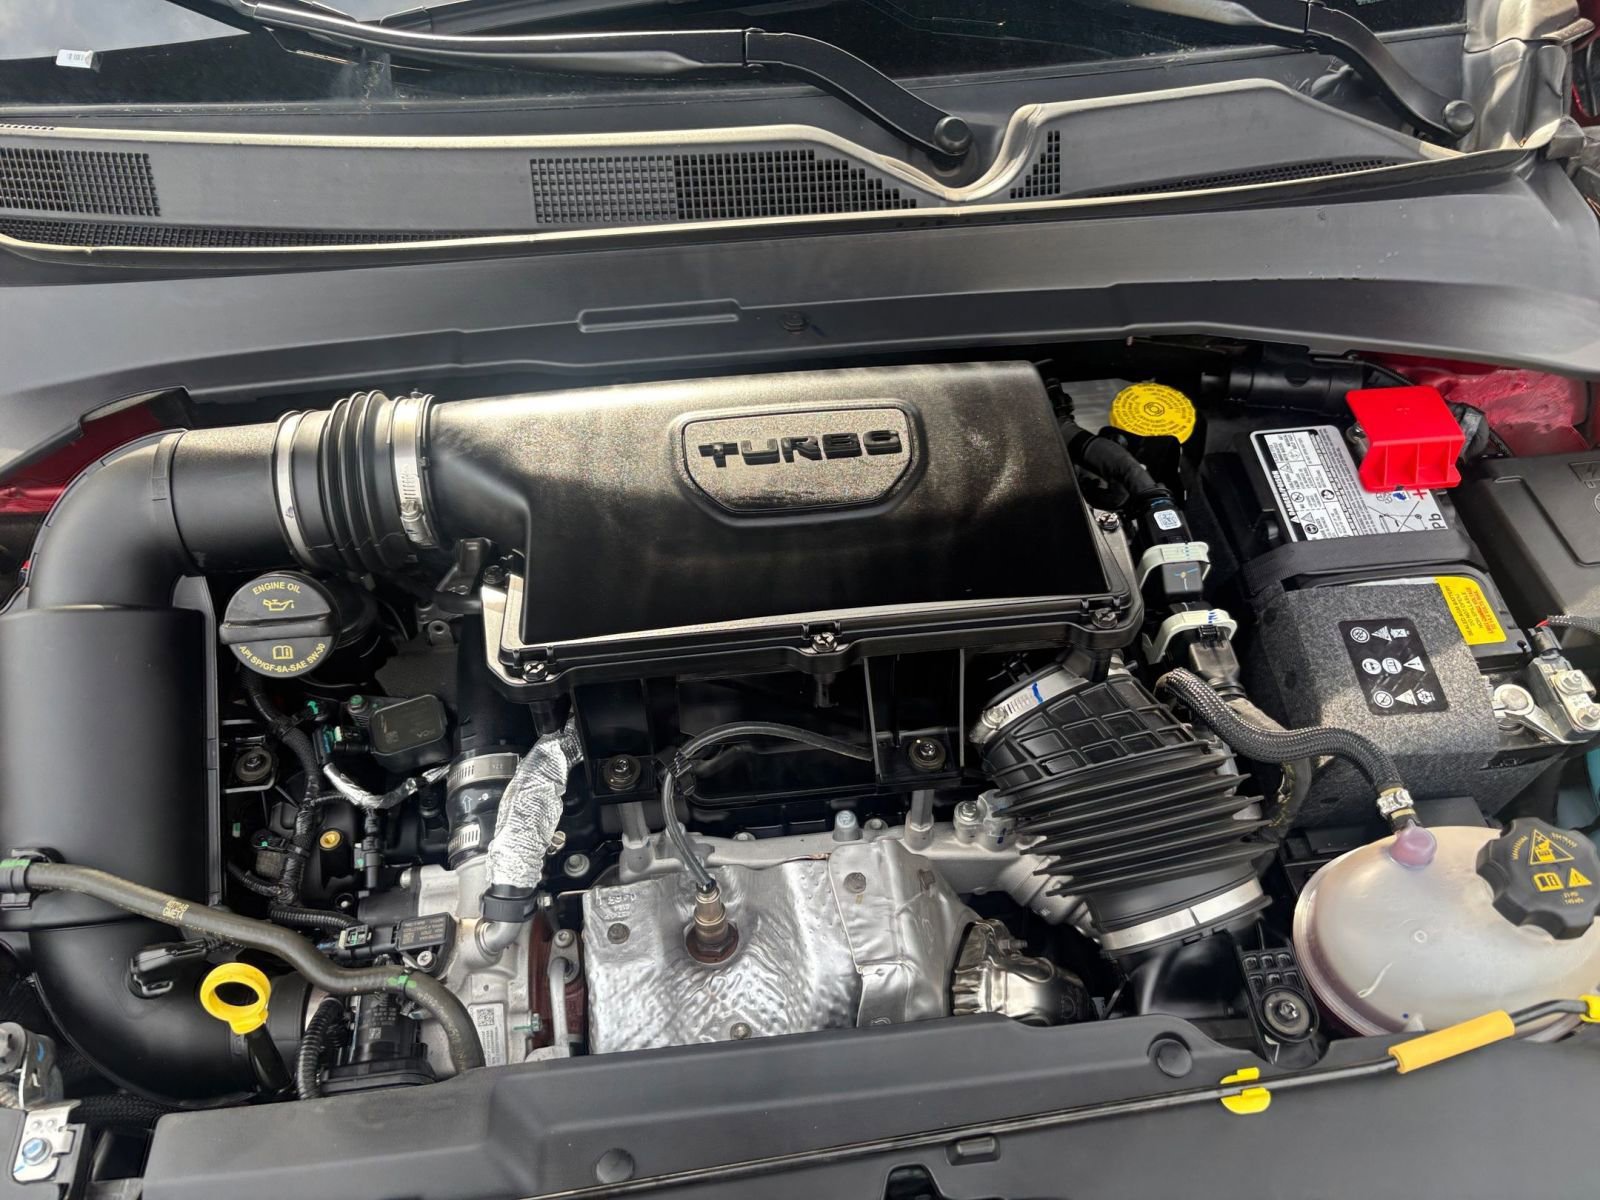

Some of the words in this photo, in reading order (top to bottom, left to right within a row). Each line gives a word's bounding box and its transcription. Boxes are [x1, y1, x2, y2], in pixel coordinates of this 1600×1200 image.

[698, 430, 902, 468] TURBO
[1428, 513, 1446, 529] Pb
[252, 581, 286, 595] ENGINE
[287, 583, 301, 594] OIL
[239, 645, 252, 660] API
[308, 643, 326, 664] 5W-30
